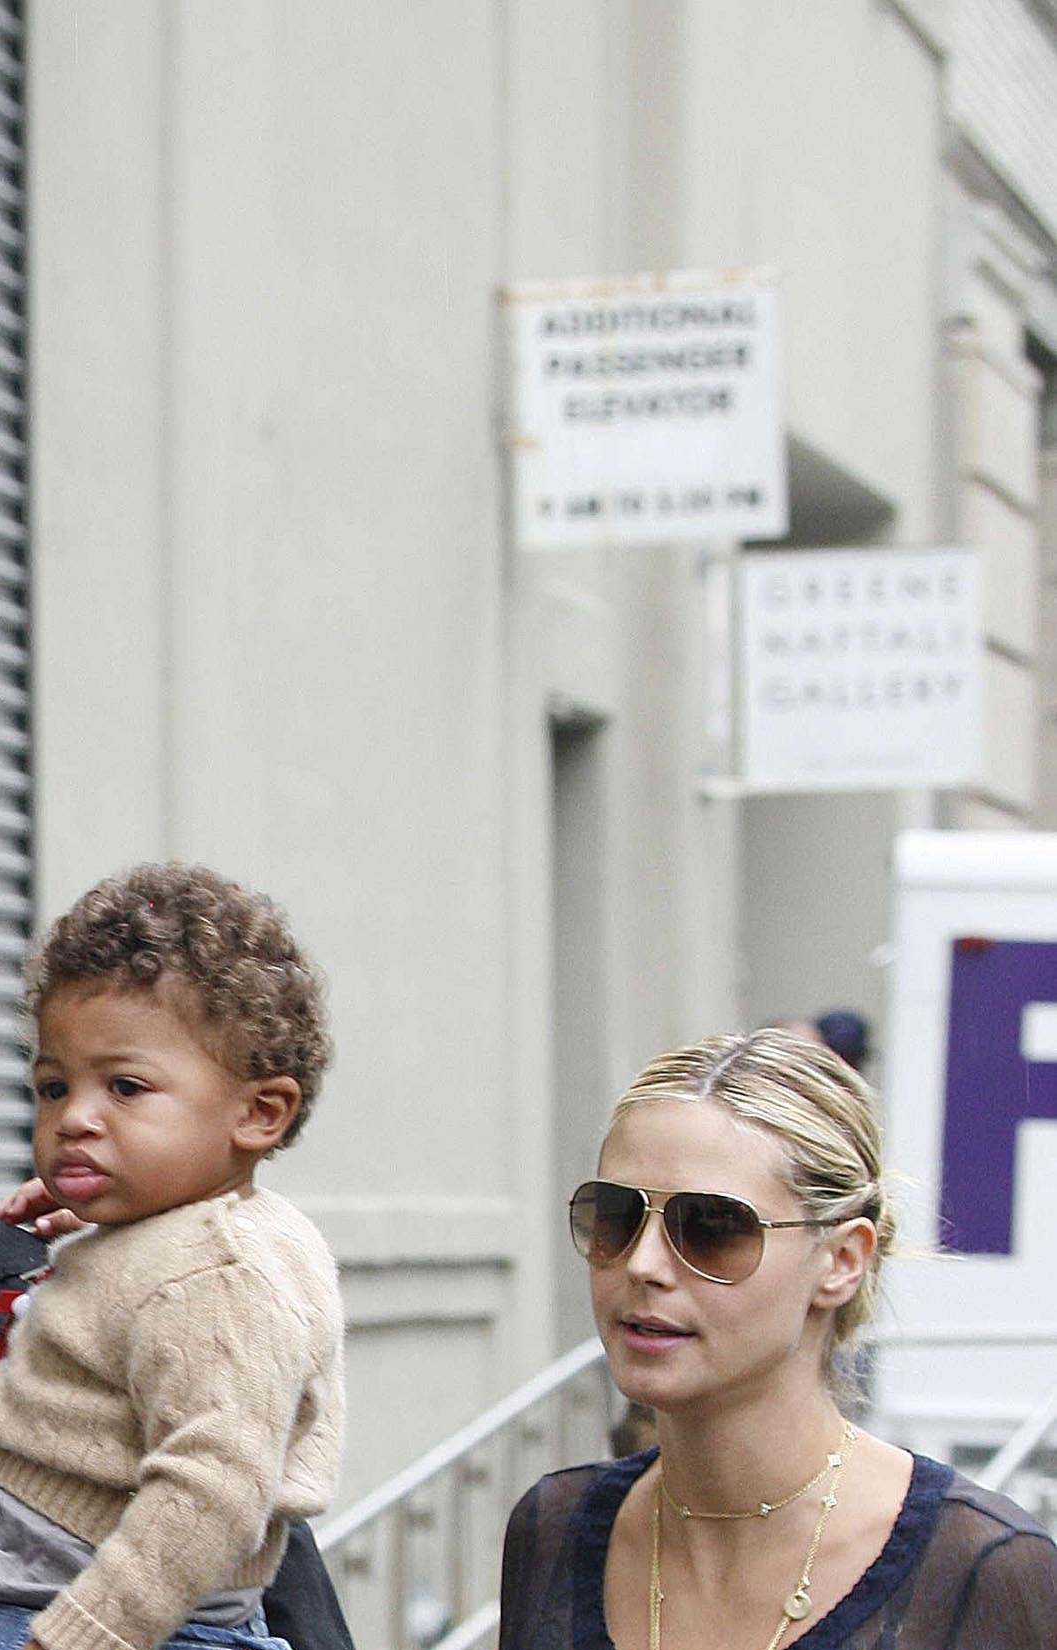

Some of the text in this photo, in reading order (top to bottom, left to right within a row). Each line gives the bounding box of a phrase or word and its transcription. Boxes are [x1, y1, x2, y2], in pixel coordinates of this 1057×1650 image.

[541, 302, 755, 337] ADDITIONAL
[543, 344, 748, 378] PASSENGER
[563, 388, 732, 423] ELEVATOR
[761, 567, 959, 611] GREENE
[759, 620, 965, 659] NAFTALI
[759, 671, 962, 713] GALLERY
